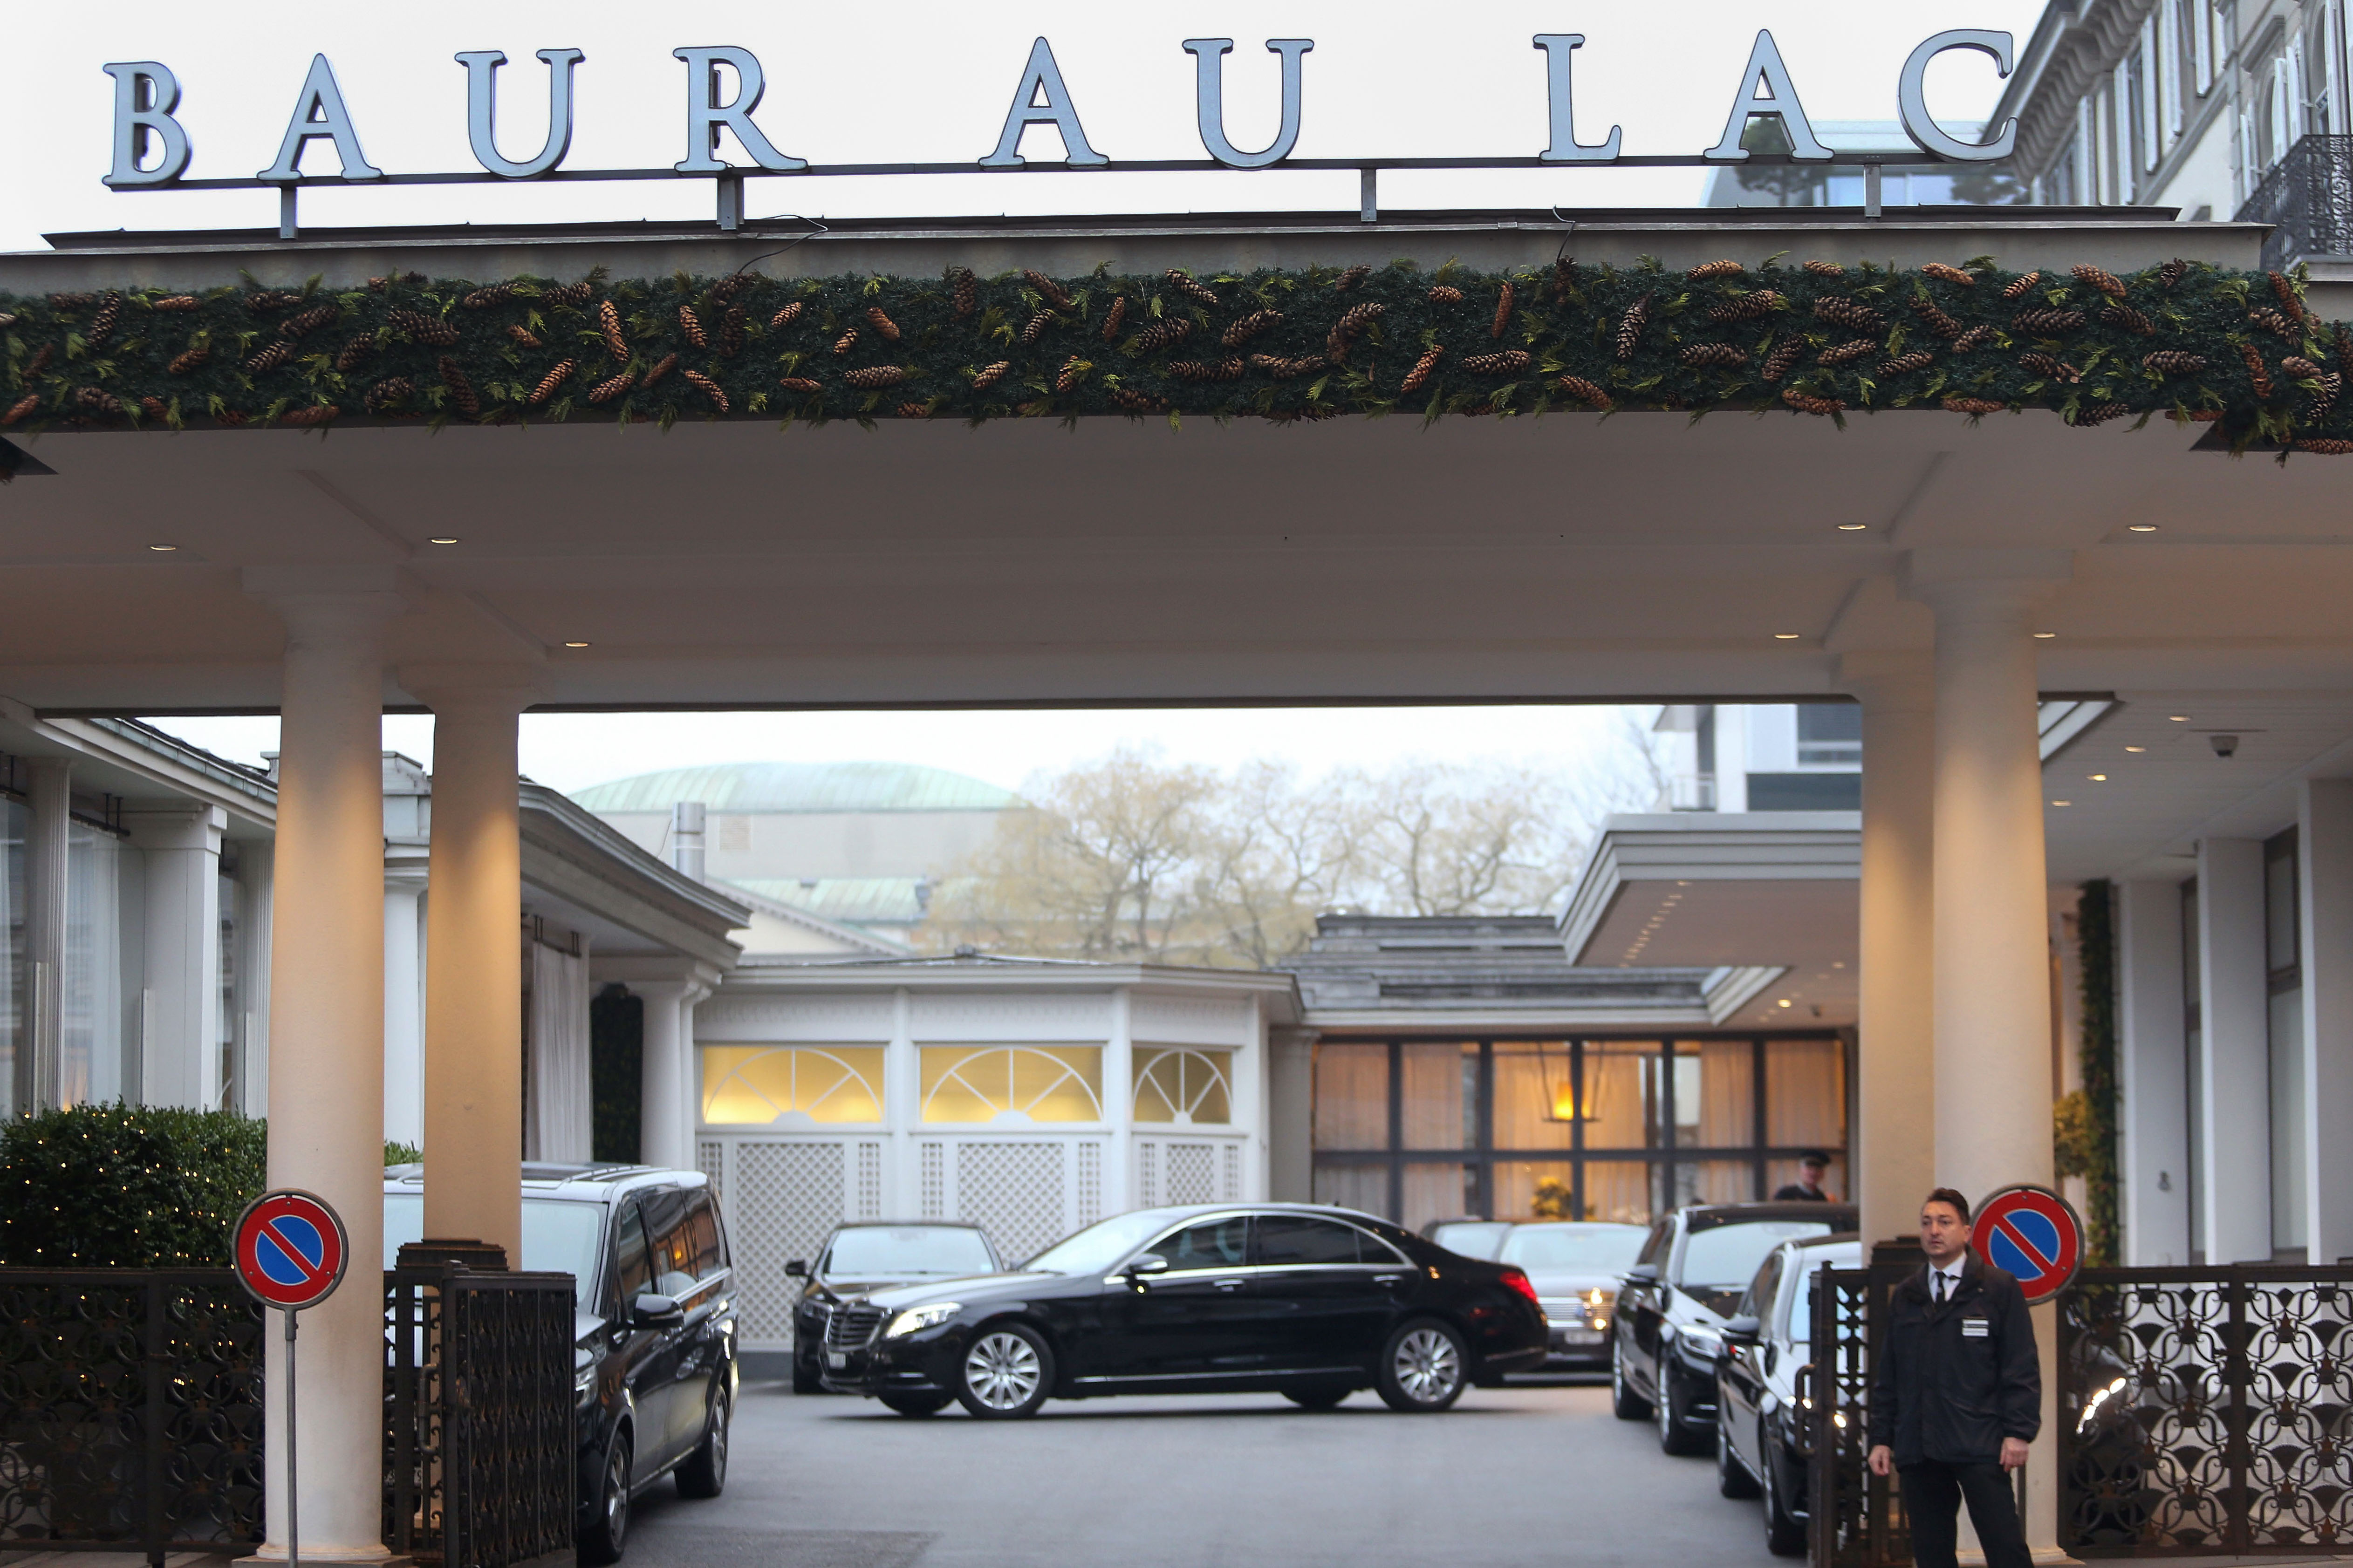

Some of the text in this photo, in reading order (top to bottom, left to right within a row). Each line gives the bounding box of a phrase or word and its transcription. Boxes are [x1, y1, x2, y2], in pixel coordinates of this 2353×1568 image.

[102, 28, 2018, 186] BAUR AU LAC
